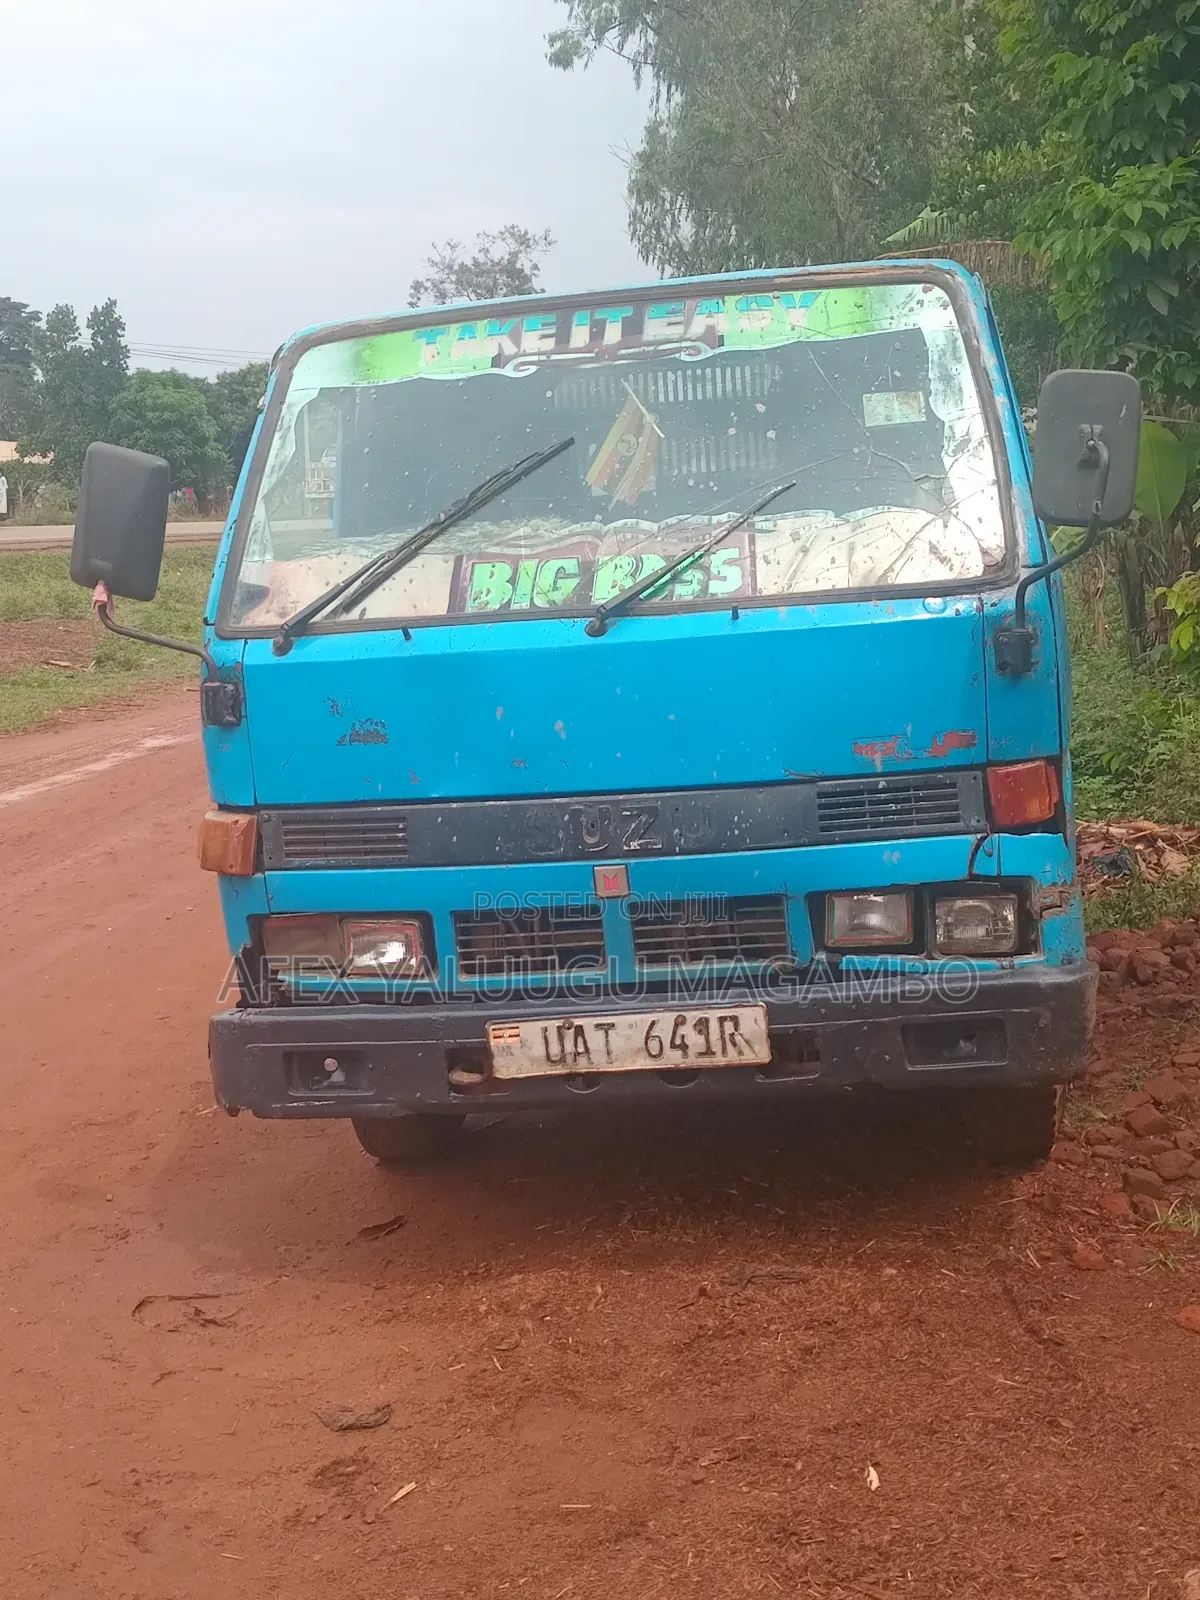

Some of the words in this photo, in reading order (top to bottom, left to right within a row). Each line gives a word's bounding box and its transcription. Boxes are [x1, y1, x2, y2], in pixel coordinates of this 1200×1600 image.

[413, 314, 558, 363] TAKE
[569, 304, 634, 349] IT
[641, 291, 822, 343] EASY
[467, 556, 582, 611] BIG
[541, 1018, 616, 1067] UAT
[643, 1012, 747, 1062] 641R
